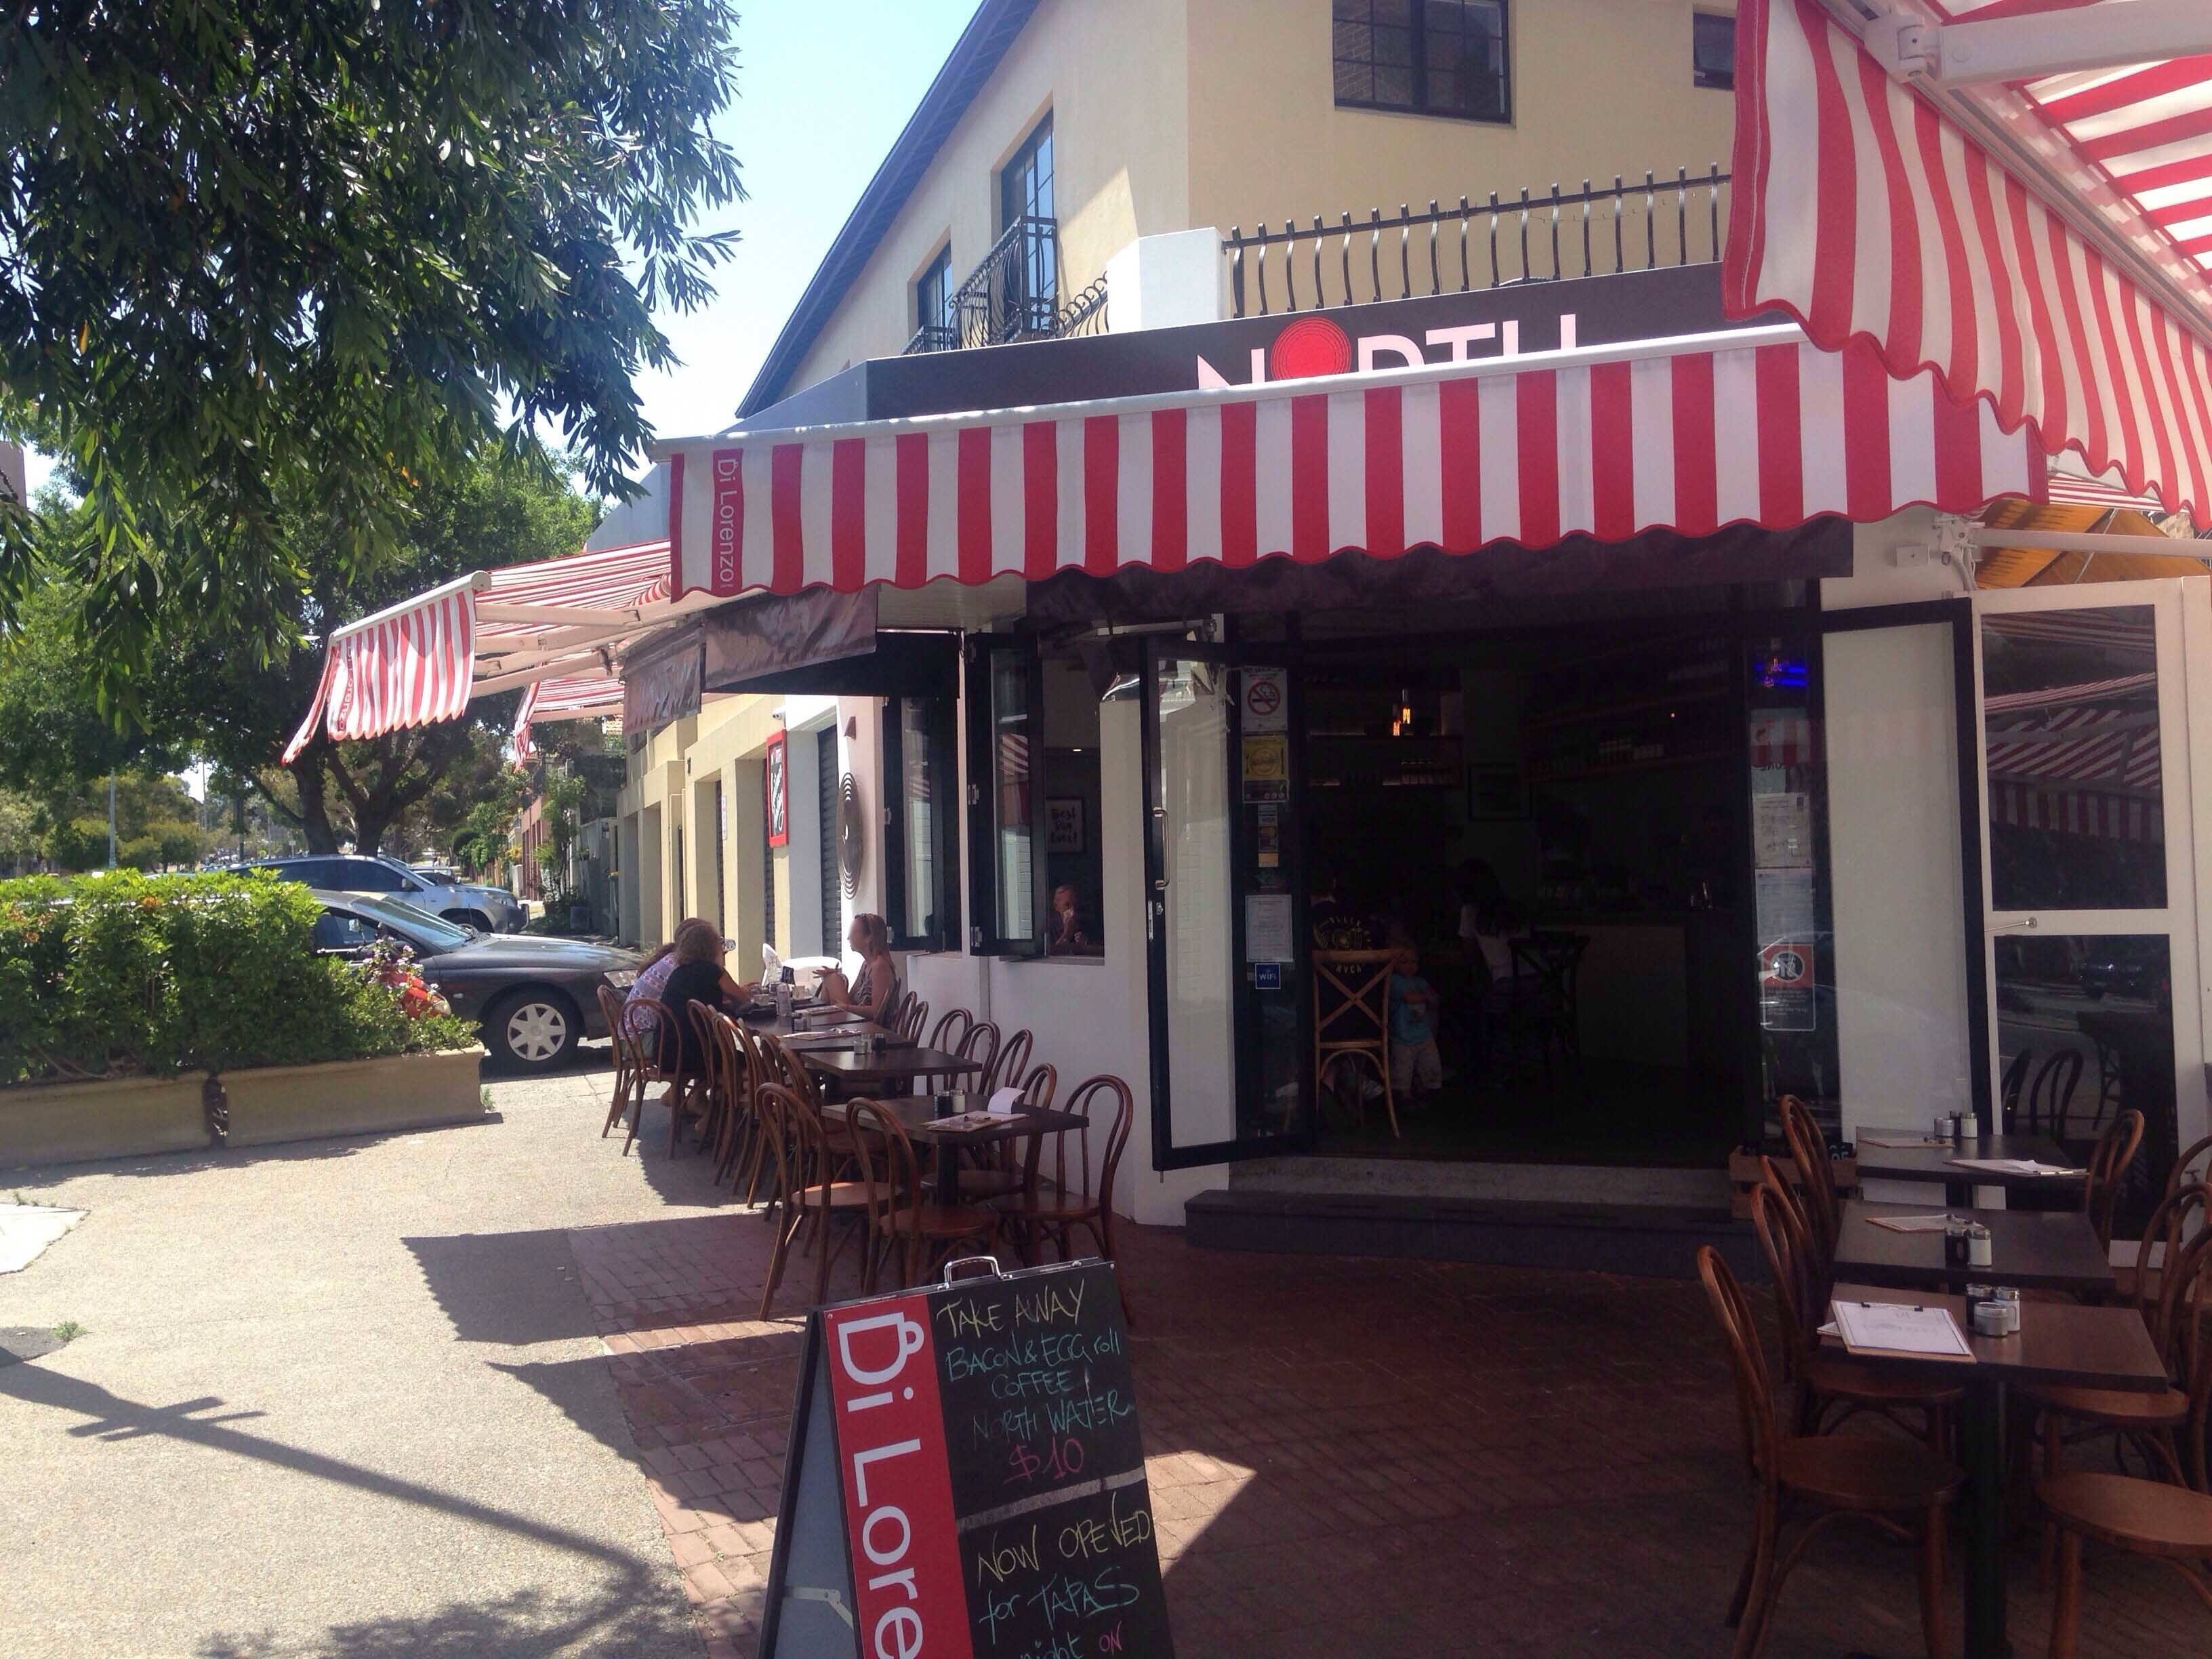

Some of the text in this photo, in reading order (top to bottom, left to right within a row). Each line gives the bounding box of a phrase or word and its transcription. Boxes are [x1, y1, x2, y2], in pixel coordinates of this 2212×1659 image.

[717, 459, 738, 582] Di Lorenzo
[936, 1279, 1084, 1338] TAKE AWAY
[838, 1312, 924, 1412] Di
[1093, 1328, 1120, 1355] roll
[991, 1370, 1075, 1399] COFFEE
[1046, 1389, 1135, 1435] WATER
[978, 1523, 1040, 1589] NOW
[979, 1565, 1141, 1645] for TAPAS
[1099, 1620, 1122, 1656] ON
